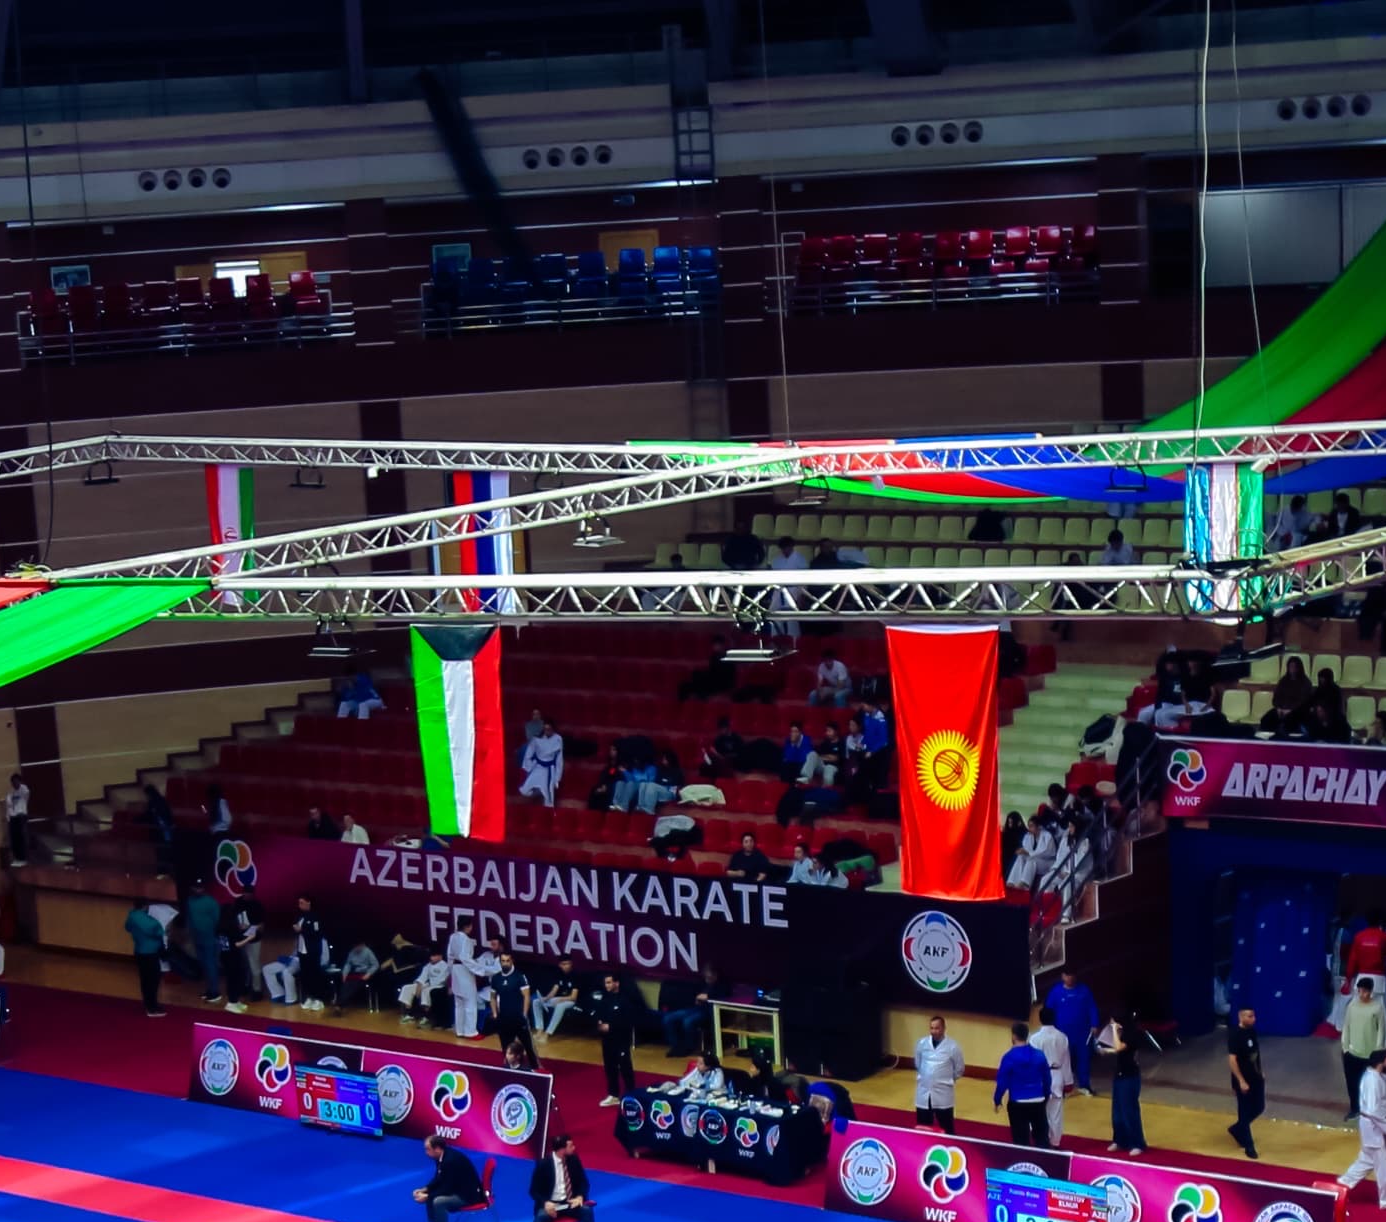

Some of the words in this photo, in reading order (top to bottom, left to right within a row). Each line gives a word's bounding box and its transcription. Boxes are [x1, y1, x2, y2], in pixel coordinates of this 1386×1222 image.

[1174, 795, 1202, 807] WKF
[349, 847, 600, 908] AZERBAIJAN
[610, 871, 790, 929] KARATE
[923, 945, 949, 957] AKF
[259, 1095, 283, 1110] WKF
[303, 1092, 312, 1109] 0
[324, 1101, 355, 1121] 3:00
[365, 1102, 375, 1121] 0
[435, 1125, 462, 1139] WKF
[856, 1165, 879, 1177] AKF
